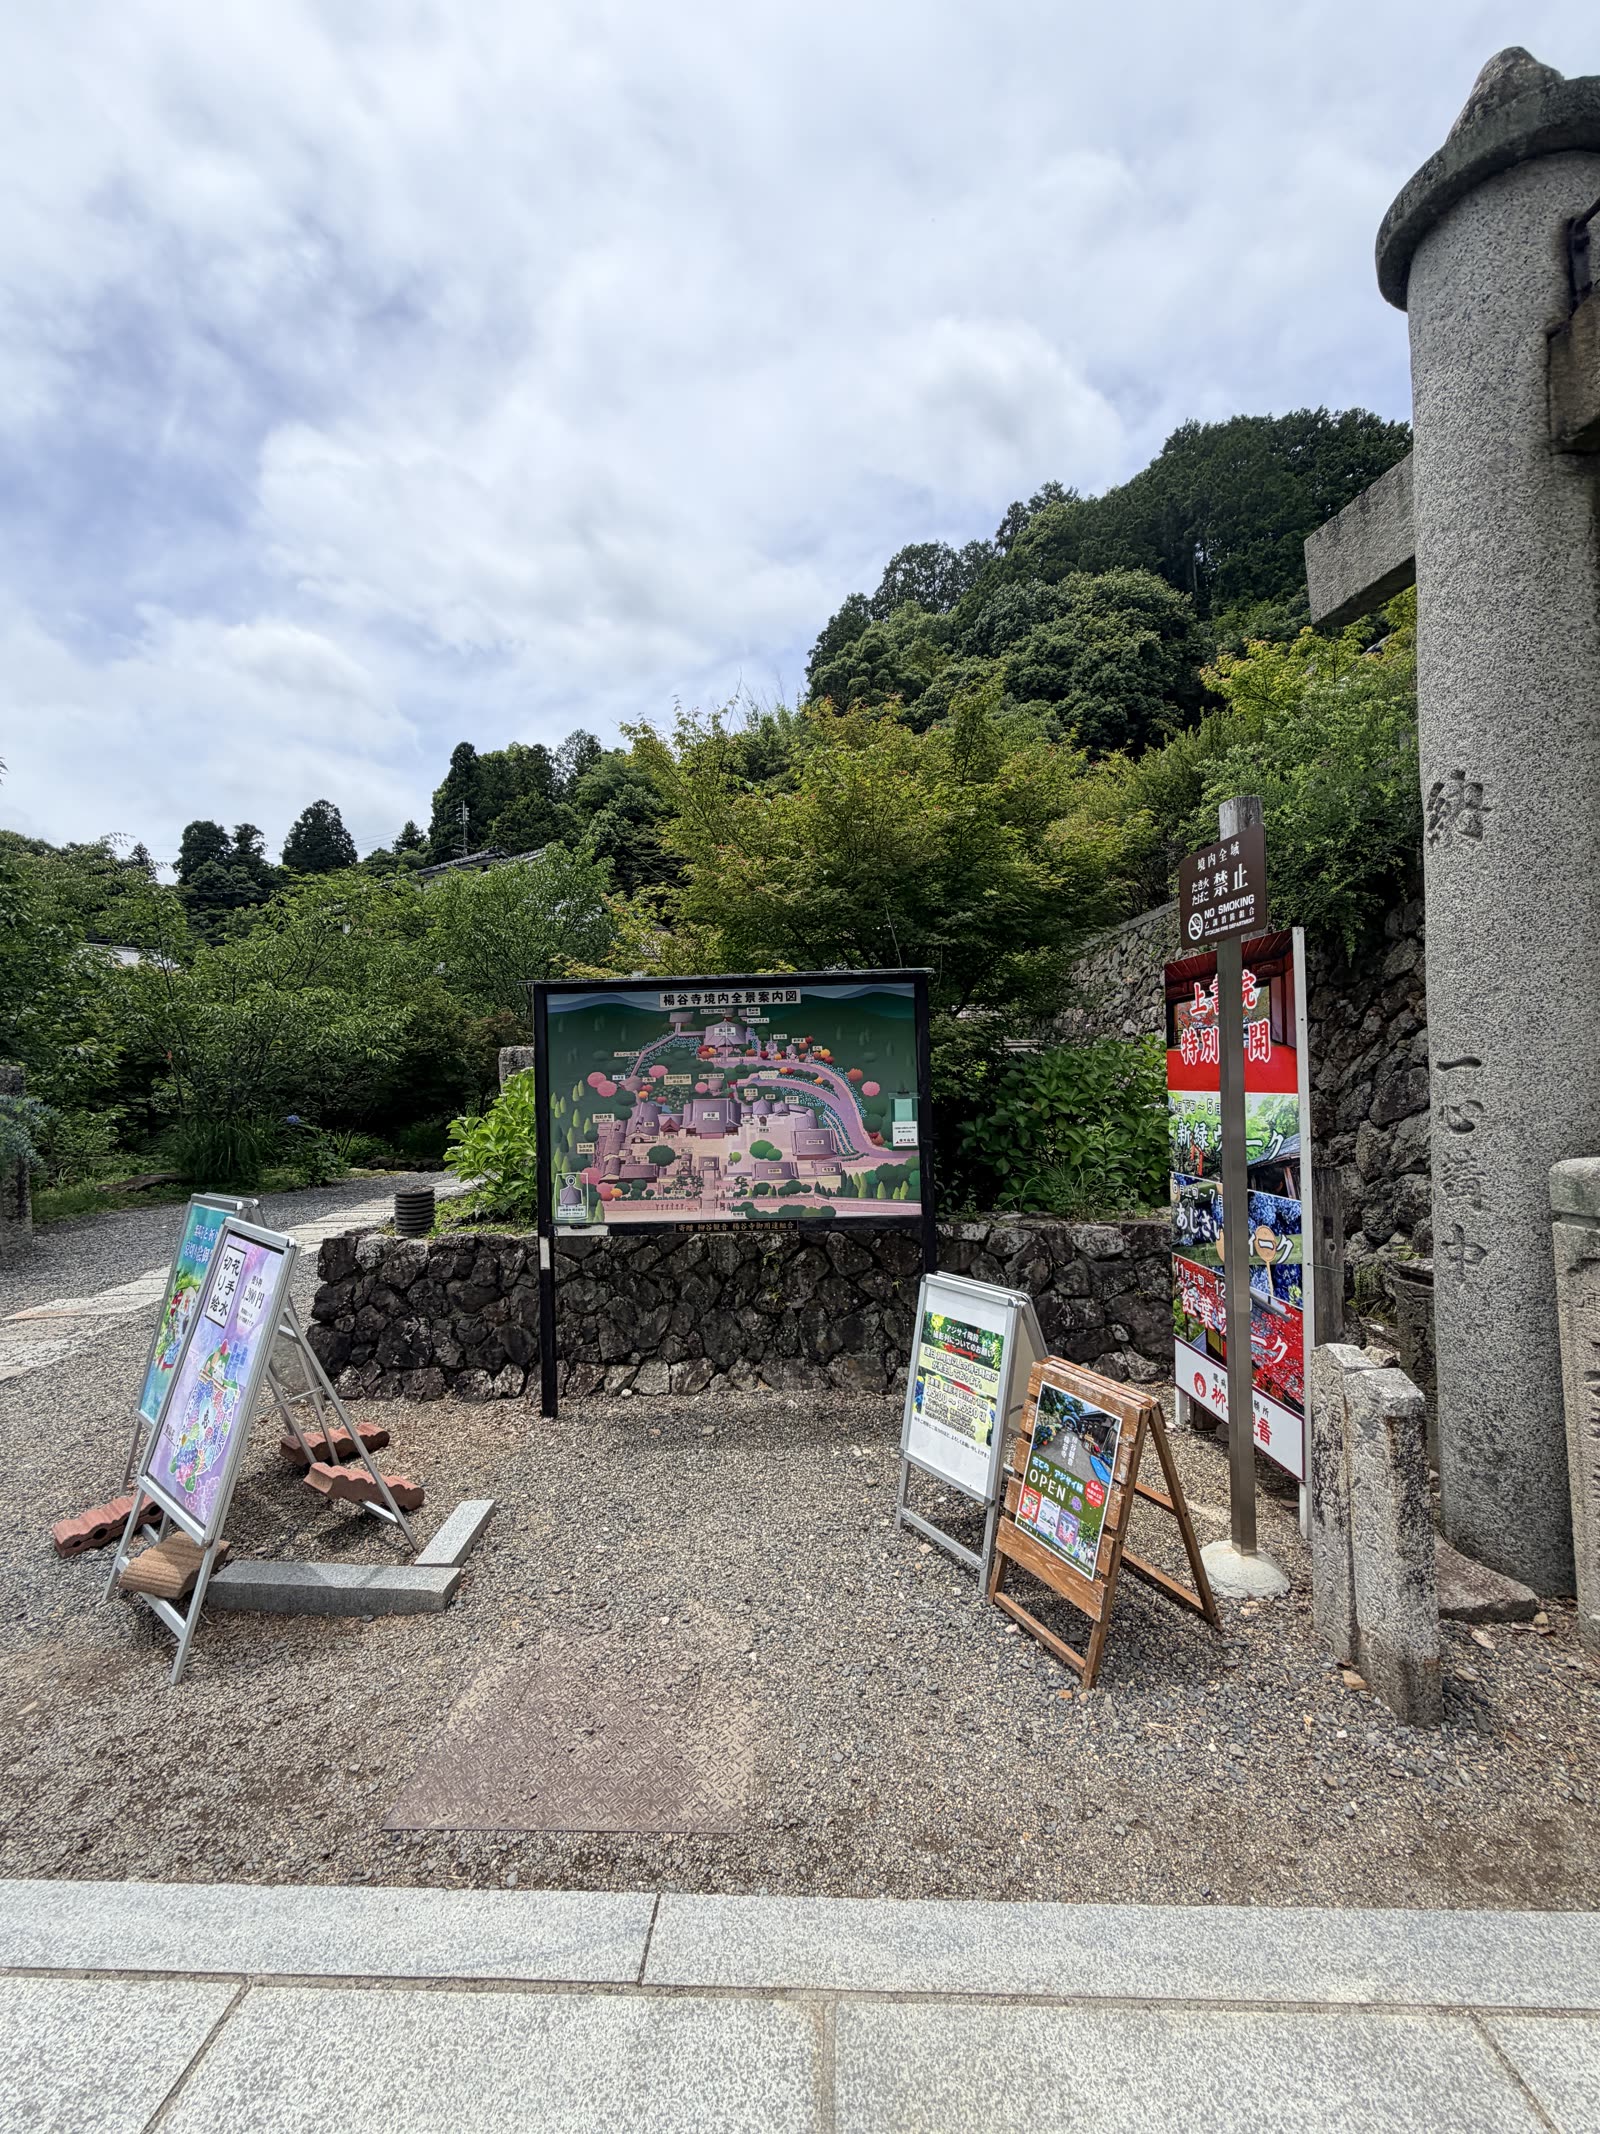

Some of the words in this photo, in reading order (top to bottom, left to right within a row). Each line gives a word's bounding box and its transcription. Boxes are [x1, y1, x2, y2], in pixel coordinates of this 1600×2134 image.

[1197, 841, 1240, 872] 境内全域
[1191, 877, 1210, 893] たき火
[1213, 863, 1248, 898] 禁止
[1191, 891, 1210, 906] たばこ
[1204, 907, 1215, 919] NO
[1218, 894, 1255, 914] SMOKING
[663, 990, 798, 1006] 楊谷寺境内全景案内図
[1181, 1017, 1271, 1065] 特別開
[210, 1254, 233, 1312] 切り絵
[219, 1259, 241, 1317] 花手水
[1211, 1385, 1273, 1446] 柳音
[1029, 1469, 1067, 1502] OPEN
